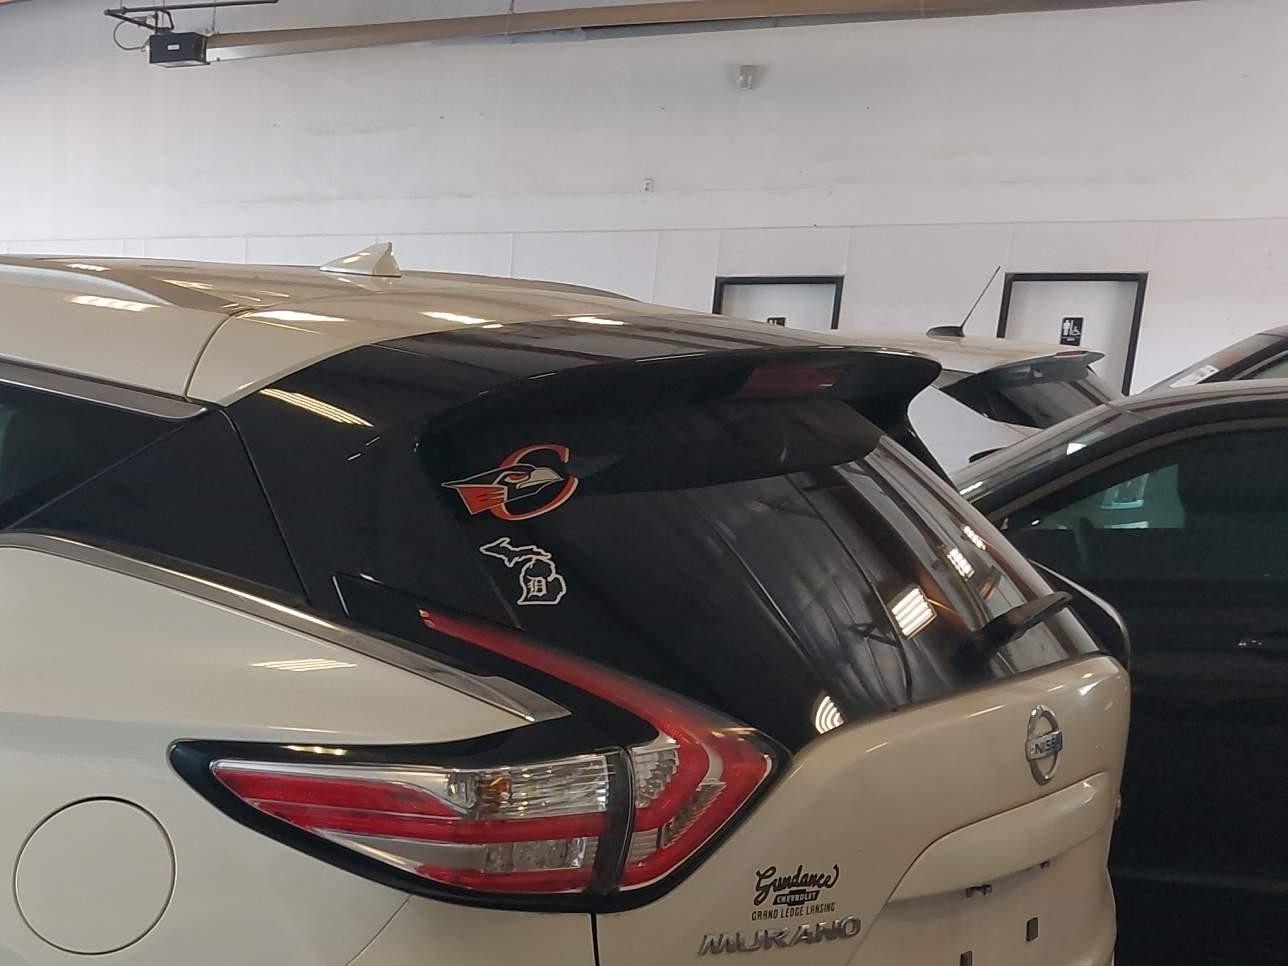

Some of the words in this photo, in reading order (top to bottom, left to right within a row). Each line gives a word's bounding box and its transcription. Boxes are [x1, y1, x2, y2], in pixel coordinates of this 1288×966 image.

[751, 909, 779, 921] GRAND
[780, 905, 804, 919] LEDGE
[806, 902, 836, 916] LANSING
[698, 917, 861, 956] MURANO
